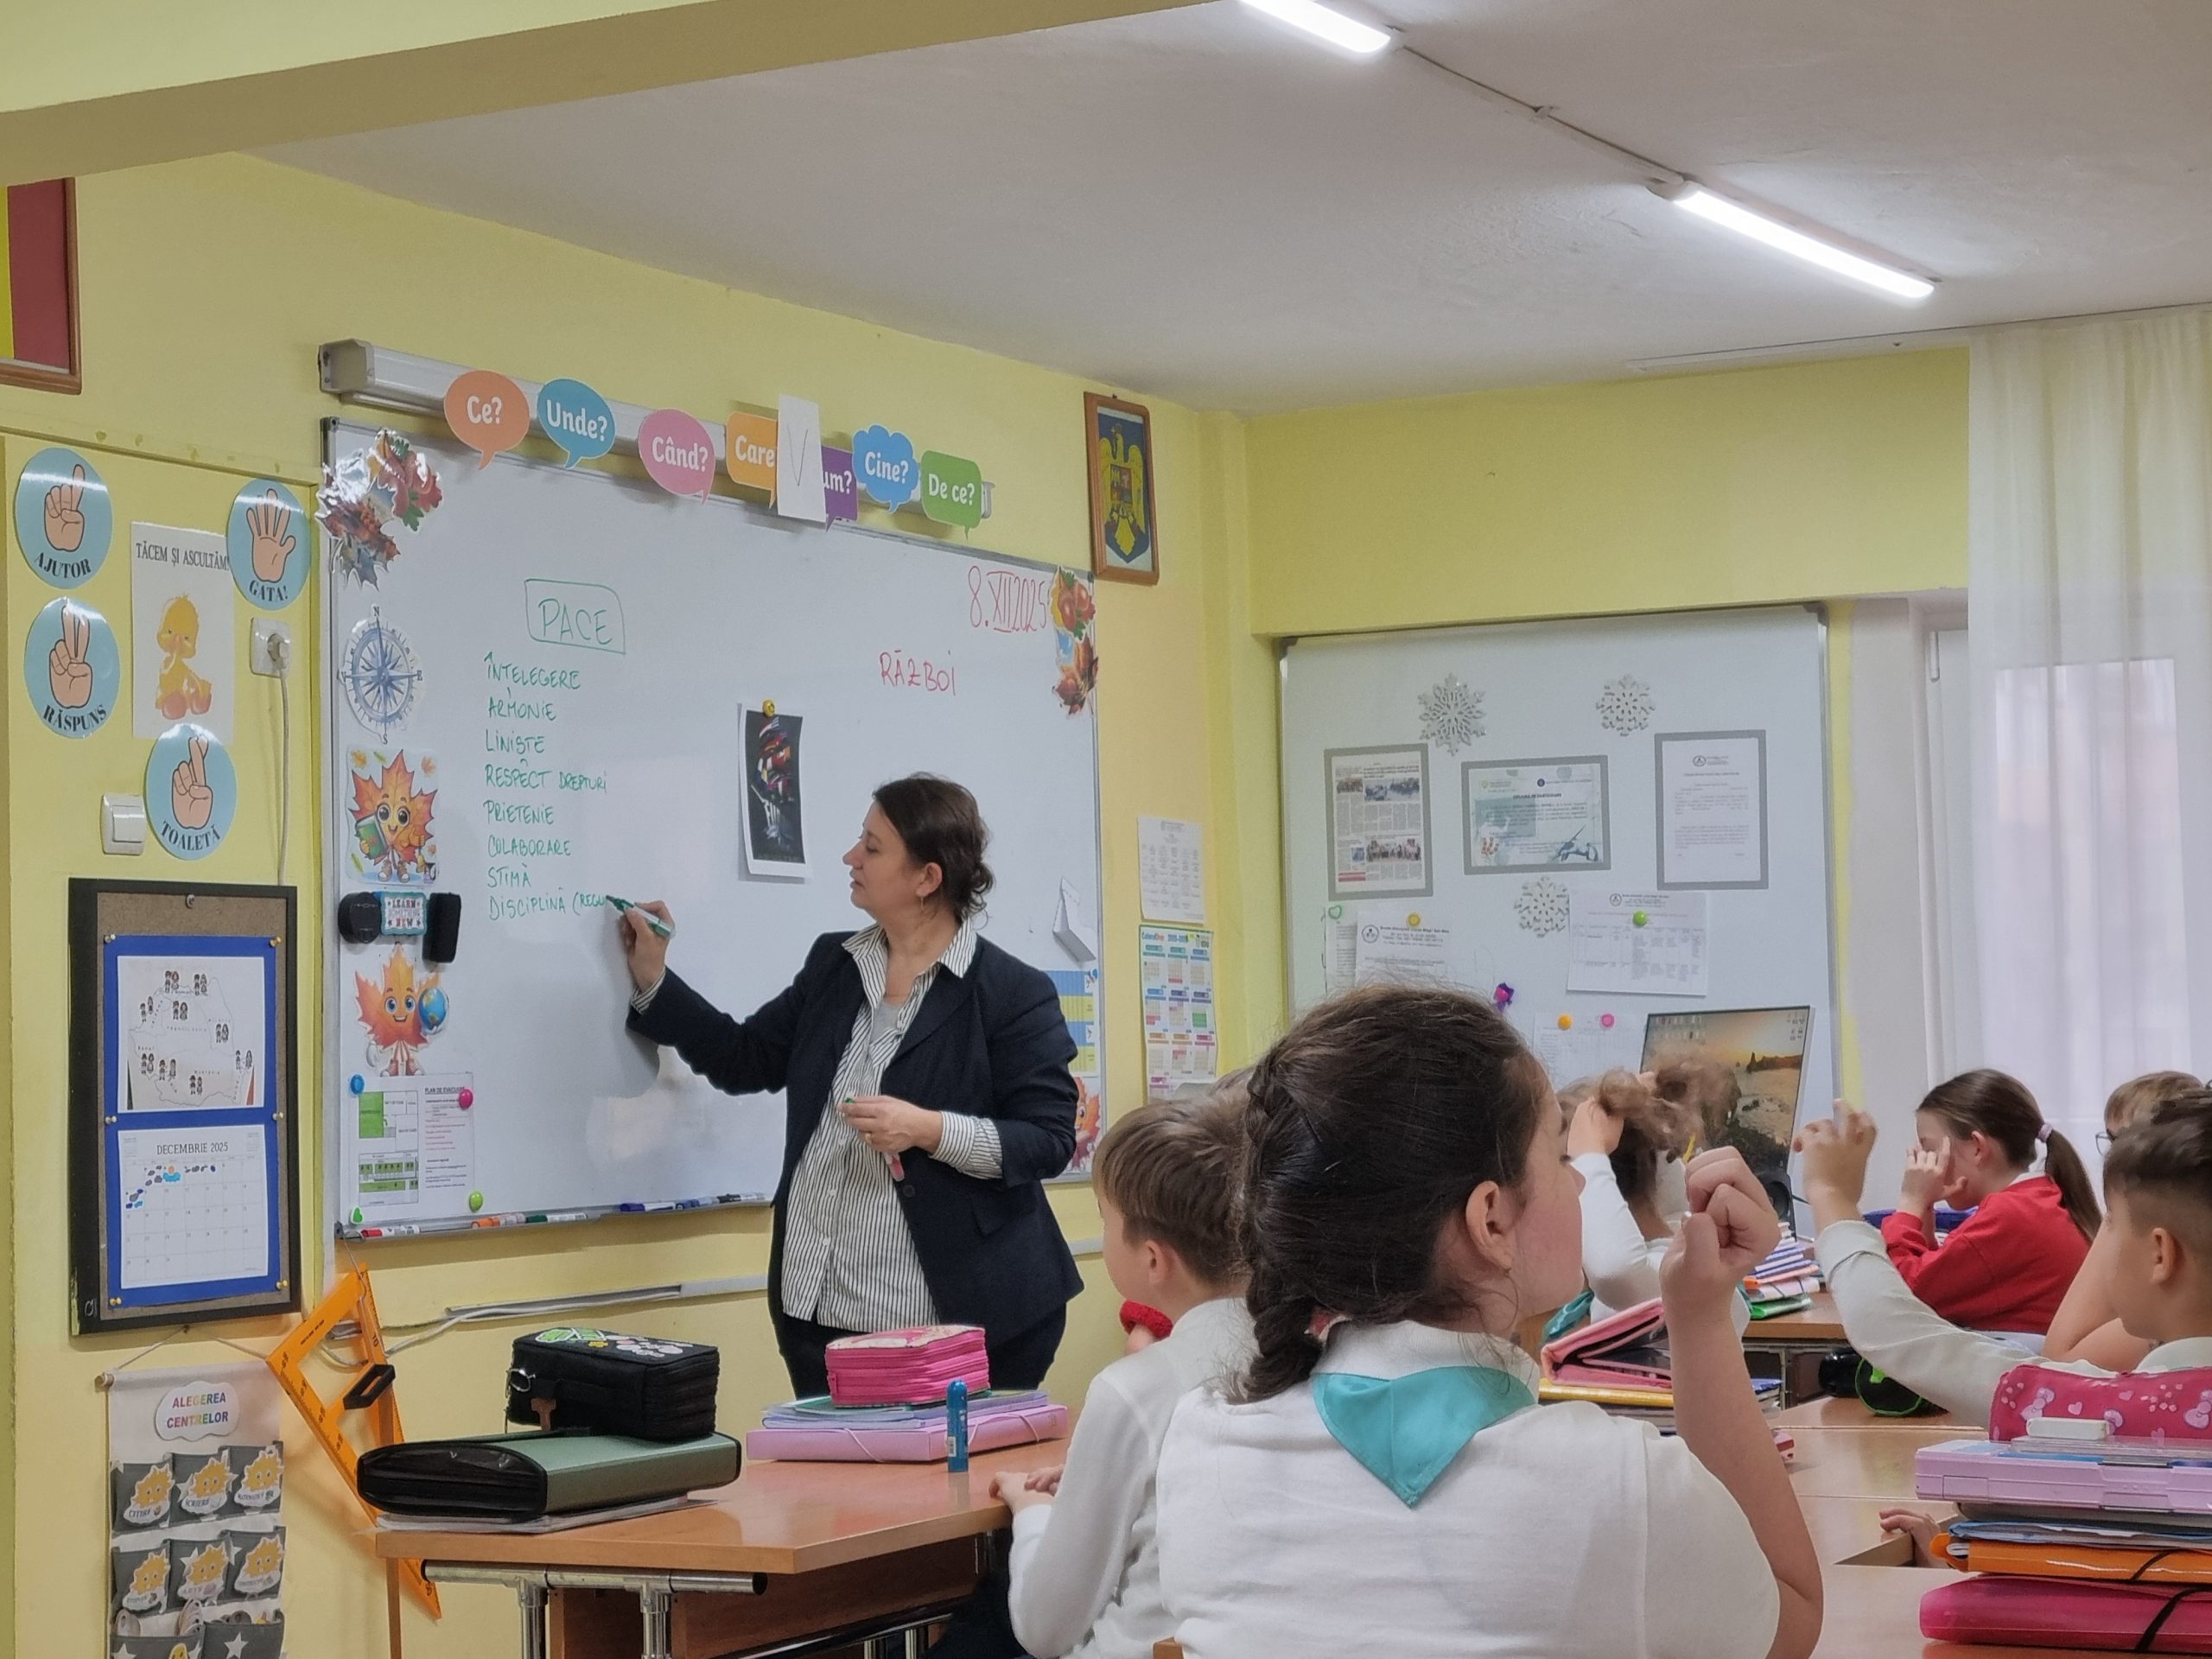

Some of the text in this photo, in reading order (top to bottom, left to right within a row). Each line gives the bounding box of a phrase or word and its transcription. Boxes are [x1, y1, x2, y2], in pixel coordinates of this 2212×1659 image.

[467, 396, 502, 424] Ce?
[546, 399, 607, 442] Unde?
[652, 435, 709, 473] Când?
[734, 435, 775, 467] Care
[865, 451, 909, 484] Cine?
[822, 470, 852, 495] um?
[928, 474, 976, 505] De ce?
[35, 552, 92, 578] AJUTOR
[136, 541, 168, 563] TĂCEM
[249, 580, 289, 602] GATA!
[537, 598, 613, 645] PACE
[880, 650, 956, 696] RĂZBOI
[43, 704, 107, 732] RĂSPUNS
[488, 696, 557, 721] ARMONIE
[484, 764, 552, 790] RESPECT
[483, 799, 554, 825] PRIETENIE
[162, 820, 221, 851] TOALETĂ
[487, 834, 572, 858] COLABORARE
[156, 1141, 229, 1155] DECEMBRIE 2025
[172, 1392, 226, 1409] ALEGEREA
[166, 1411, 229, 1429] CENTRELOR
